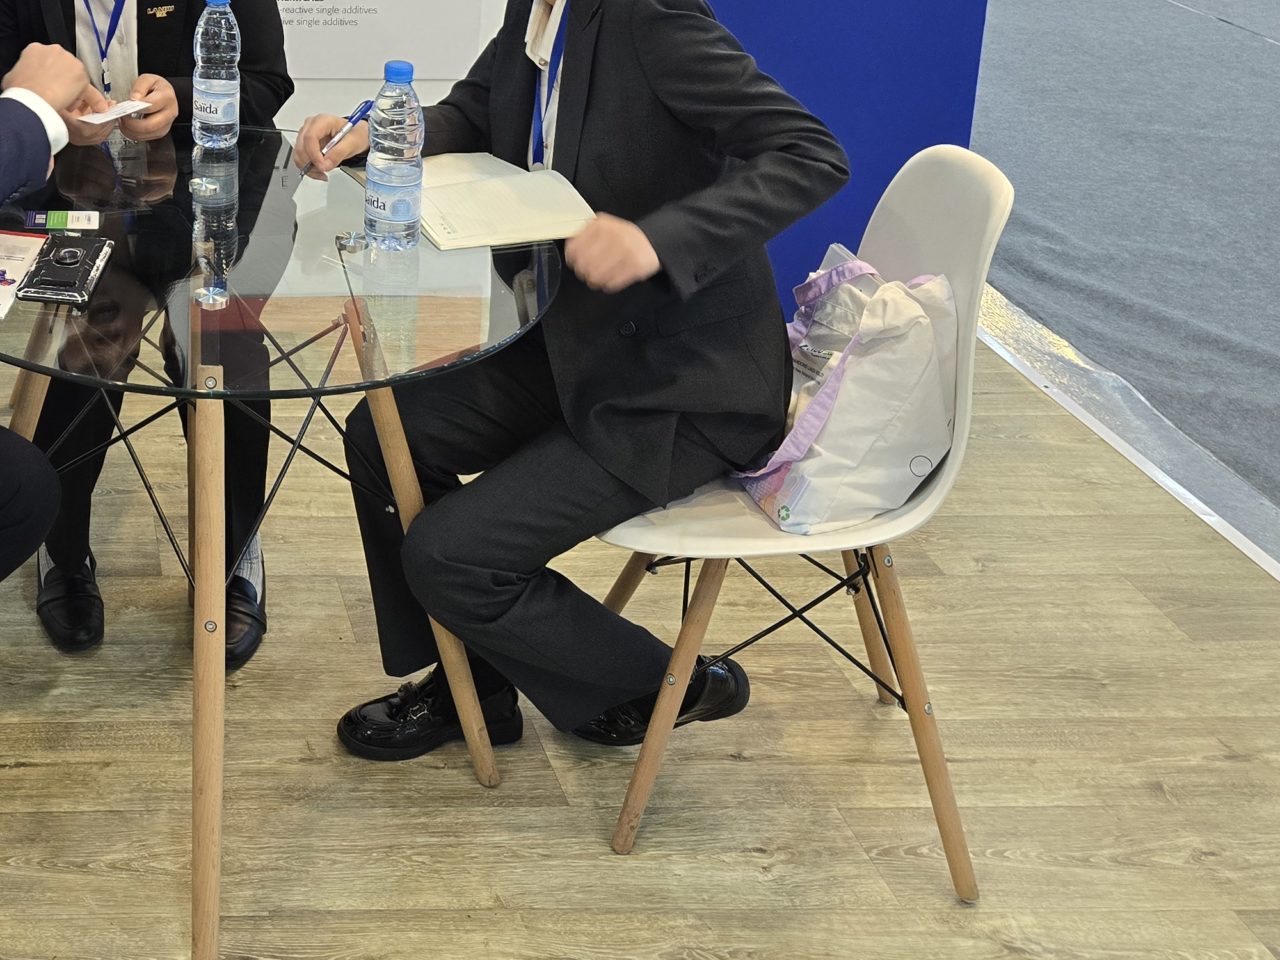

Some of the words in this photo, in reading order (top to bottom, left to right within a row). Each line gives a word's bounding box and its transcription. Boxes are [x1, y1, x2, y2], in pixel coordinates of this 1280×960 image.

[316, 6, 339, 16] single
[342, 5, 378, 14] additives
[297, 18, 320, 27] single
[322, 18, 359, 26] additives
[193, 100, 218, 114] Saïda
